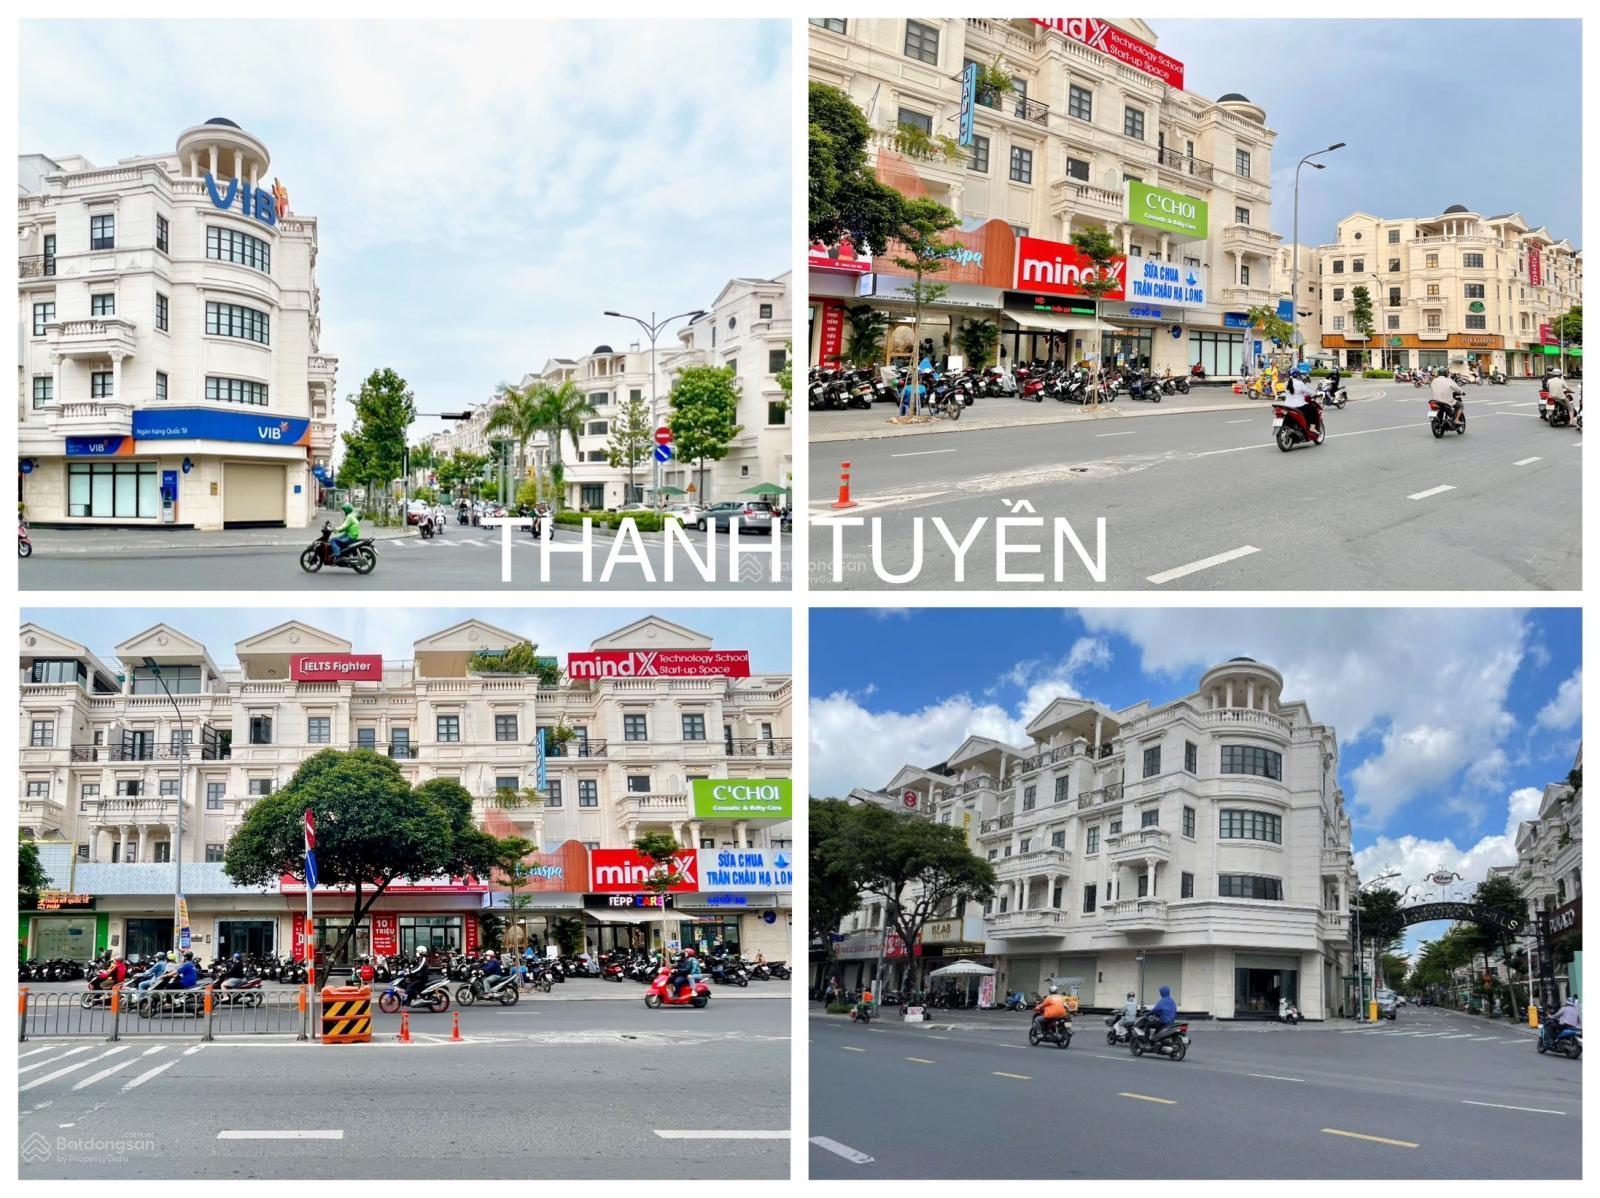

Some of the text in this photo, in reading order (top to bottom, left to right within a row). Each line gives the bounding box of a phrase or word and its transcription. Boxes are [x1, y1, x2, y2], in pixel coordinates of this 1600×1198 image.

[1110, 31, 1184, 74] Technology School
[1109, 45, 1169, 79] Start-up Space
[205, 170, 276, 226] VIB
[1145, 193, 1195, 219] C'CHOI
[1160, 266, 1179, 282] CHUA
[1153, 281, 1172, 300] CHÂU
[1184, 287, 1203, 303] LONG
[258, 426, 281, 440] VIB
[89, 443, 104, 452] VIB
[304, 661, 371, 673] IELTS Fighter
[571, 652, 748, 676] mindX Technology School
[659, 665, 731, 675] Start-up Space
[713, 785, 780, 800] C'CHOI
[738, 853, 764, 867] CHUA
[732, 868, 756, 886] CHÂU
[758, 871, 771, 887] HẠ
[376, 919, 388, 928] 10
